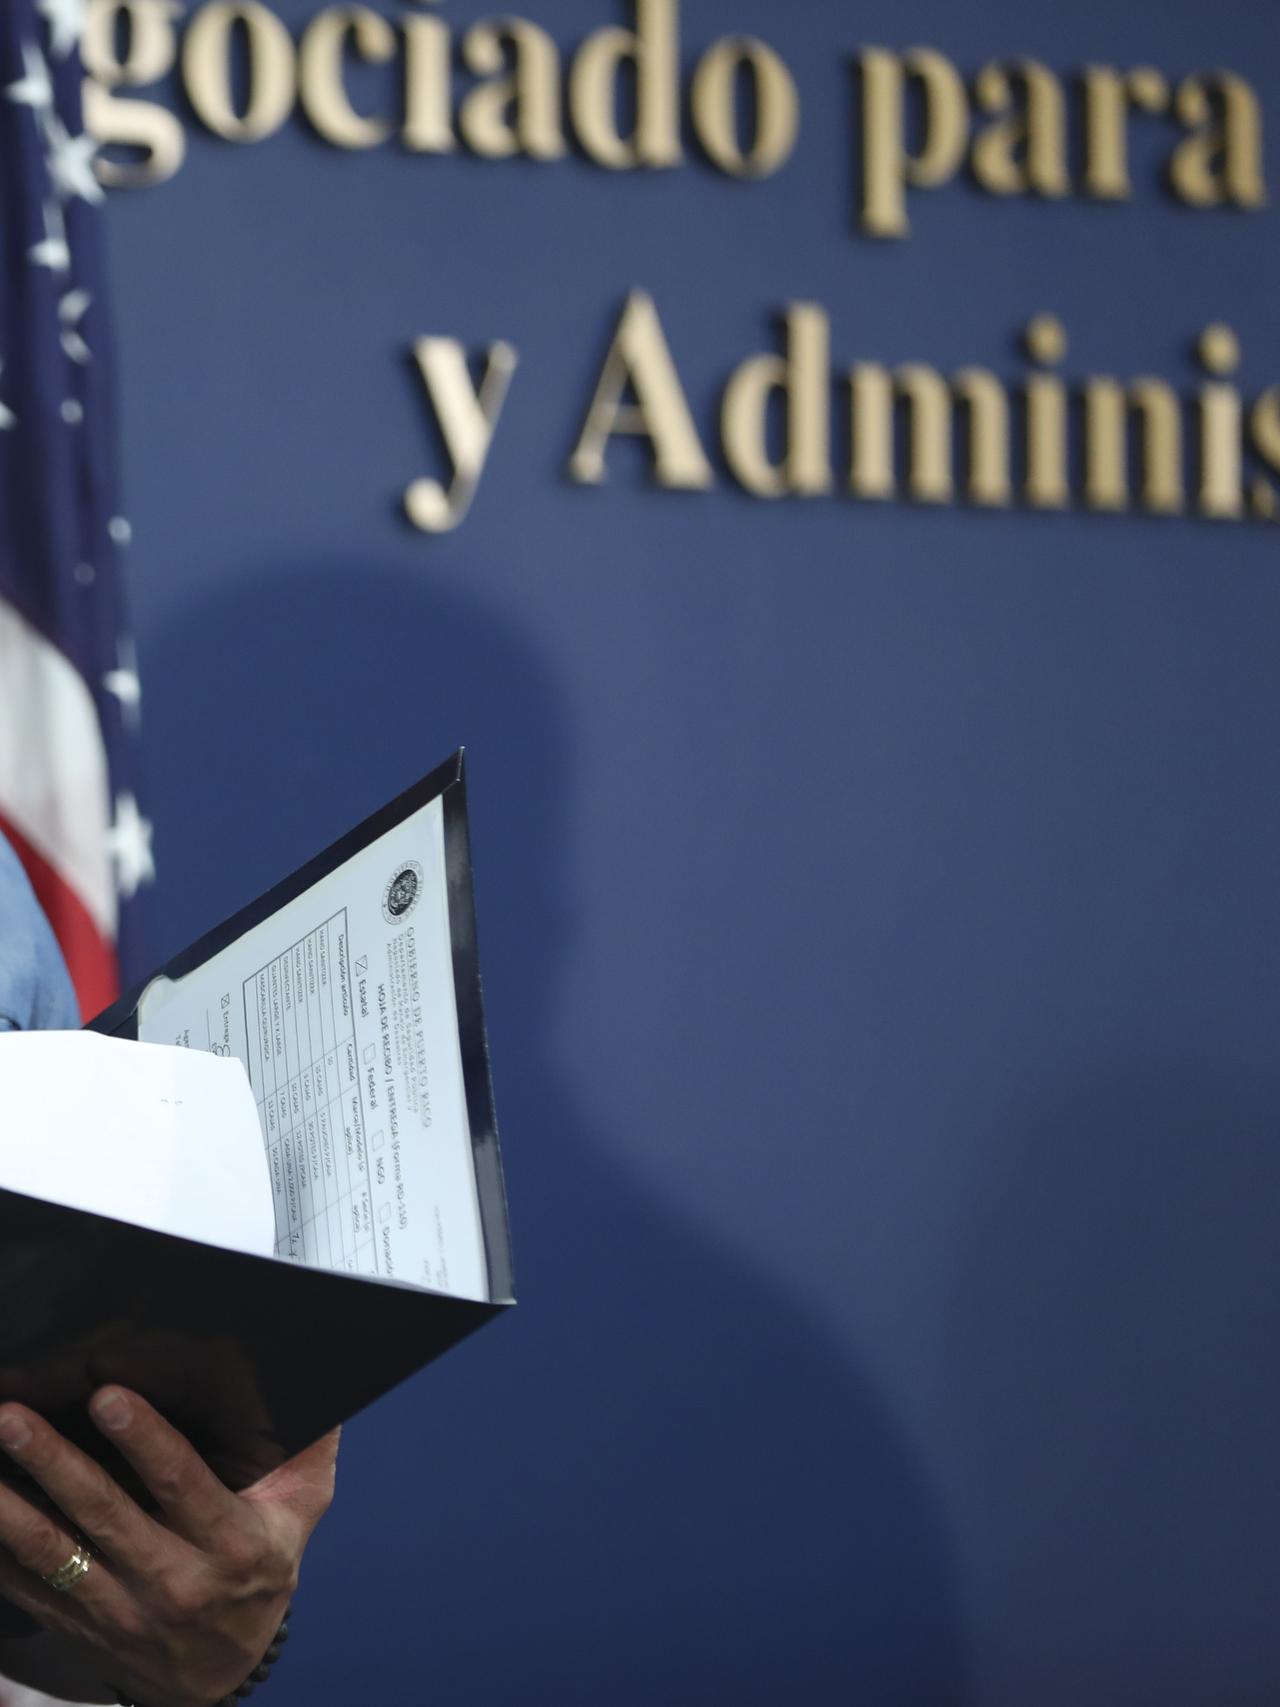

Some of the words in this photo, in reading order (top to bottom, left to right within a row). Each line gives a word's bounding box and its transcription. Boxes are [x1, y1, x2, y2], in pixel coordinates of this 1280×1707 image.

[858, 46, 1266, 238] para
[404, 336, 516, 533] y
[336, 932, 347, 984] Descripción
[406, 923, 420, 1004] GOBIERNO
[270, 963, 278, 998] GUANTES
[341, 981, 349, 1017] artículo
[358, 977, 369, 1019] Estatal
[377, 981, 386, 1016] HOJA
[380, 1014, 388, 1034] DE
[413, 1003, 423, 1028] DE
[346, 1040, 355, 1083] Cantidad
[382, 1032, 392, 1077] RECIBO
[415, 1028, 428, 1089] PUERTO
[367, 1064, 378, 1112] Federal
[420, 1088, 432, 1130] RICO
[387, 1083, 398, 1140] ENTREGA
[375, 1154, 385, 1187] NGO
[392, 1137, 403, 1183] (Forma
